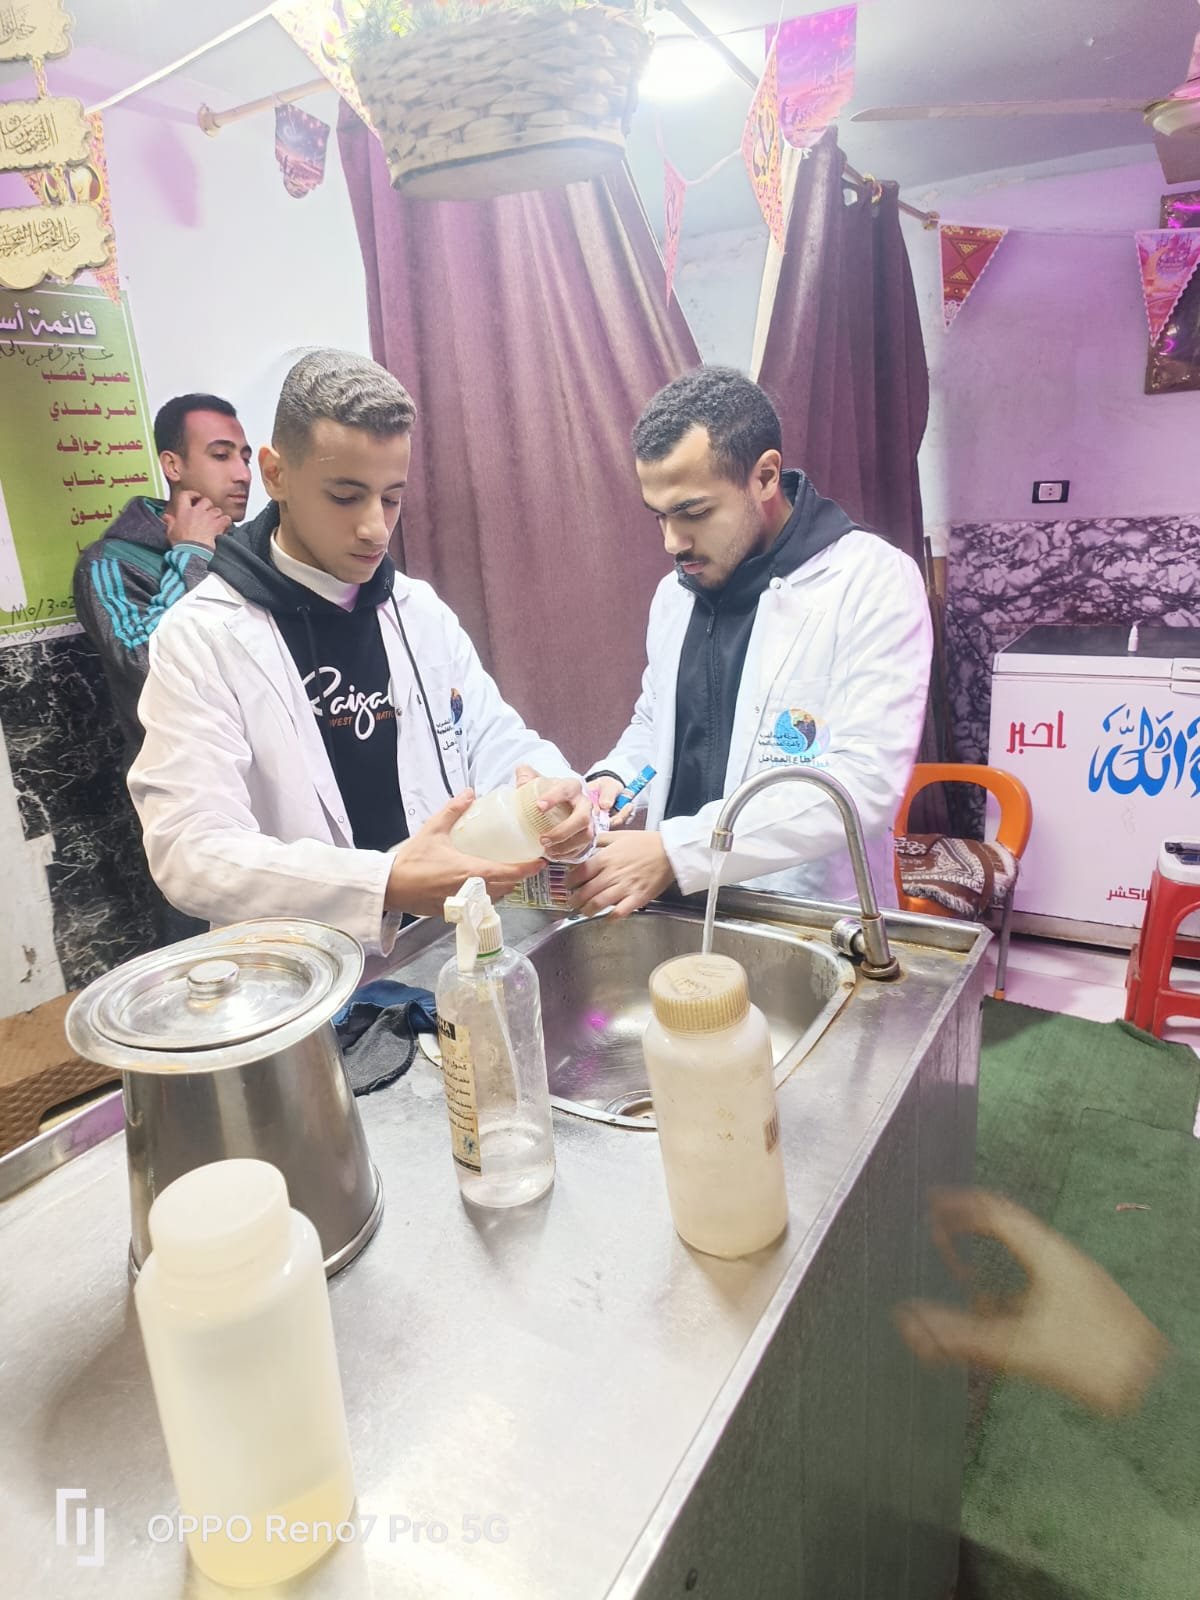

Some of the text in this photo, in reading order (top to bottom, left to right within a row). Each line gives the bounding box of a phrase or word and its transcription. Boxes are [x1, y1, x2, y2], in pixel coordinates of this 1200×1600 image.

[0, 302, 97, 336] قائمة أس
[41, 363, 130, 386] عصير قصب
[49, 399, 137, 421] تمر هندي
[56, 434, 143, 456] عصير جوافه
[62, 469, 149, 492] عصير عناب
[70, 504, 112, 526] ليمون
